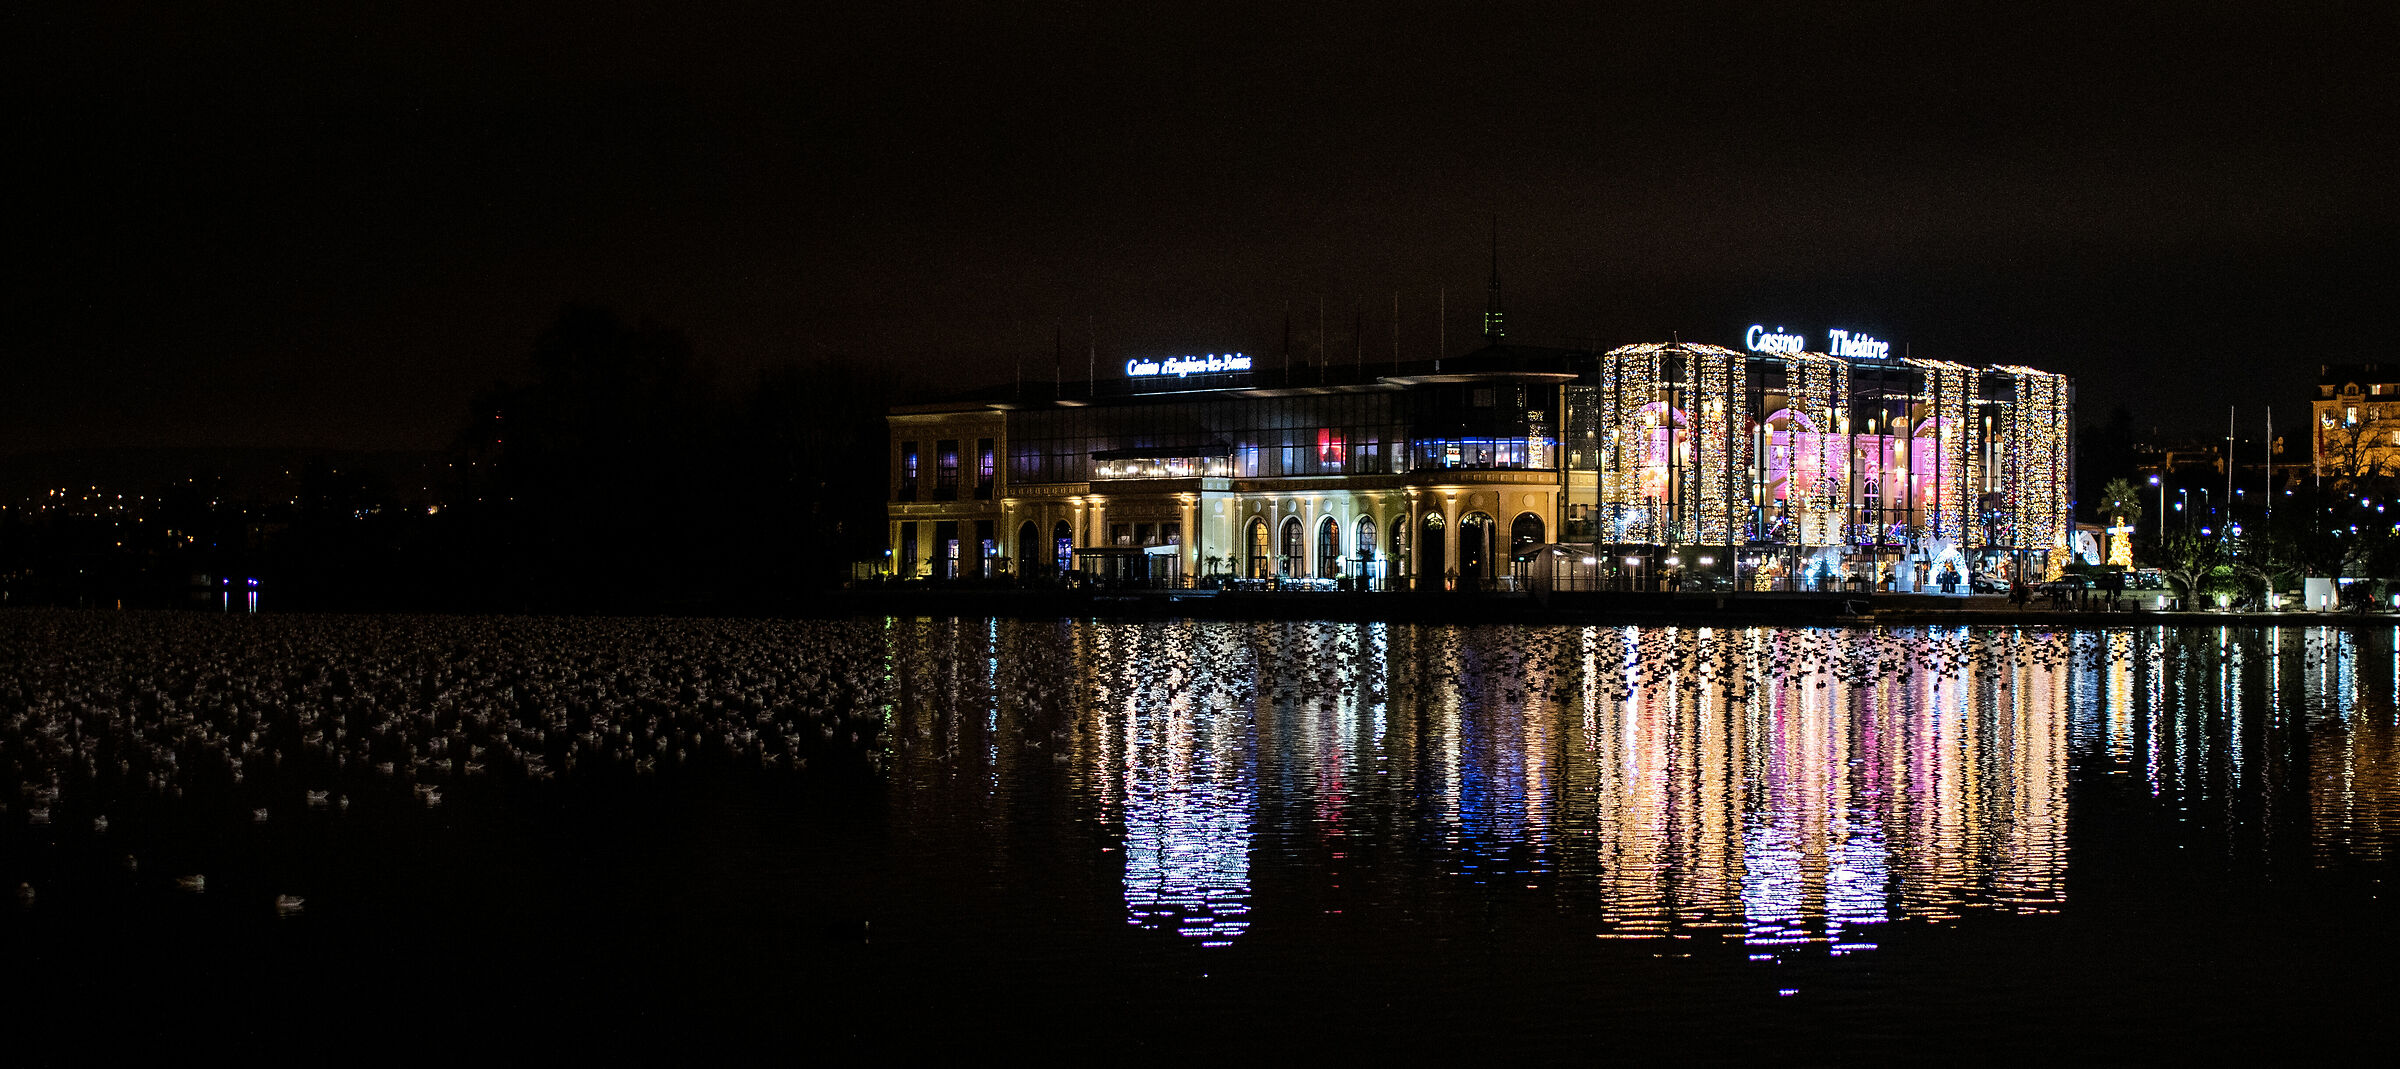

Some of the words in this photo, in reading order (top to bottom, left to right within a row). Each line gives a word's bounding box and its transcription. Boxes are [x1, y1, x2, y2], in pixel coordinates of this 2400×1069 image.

[1746, 324, 1804, 353] Casino
[1829, 328, 1889, 359] Théâtre
[1126, 358, 1160, 376] Casino
